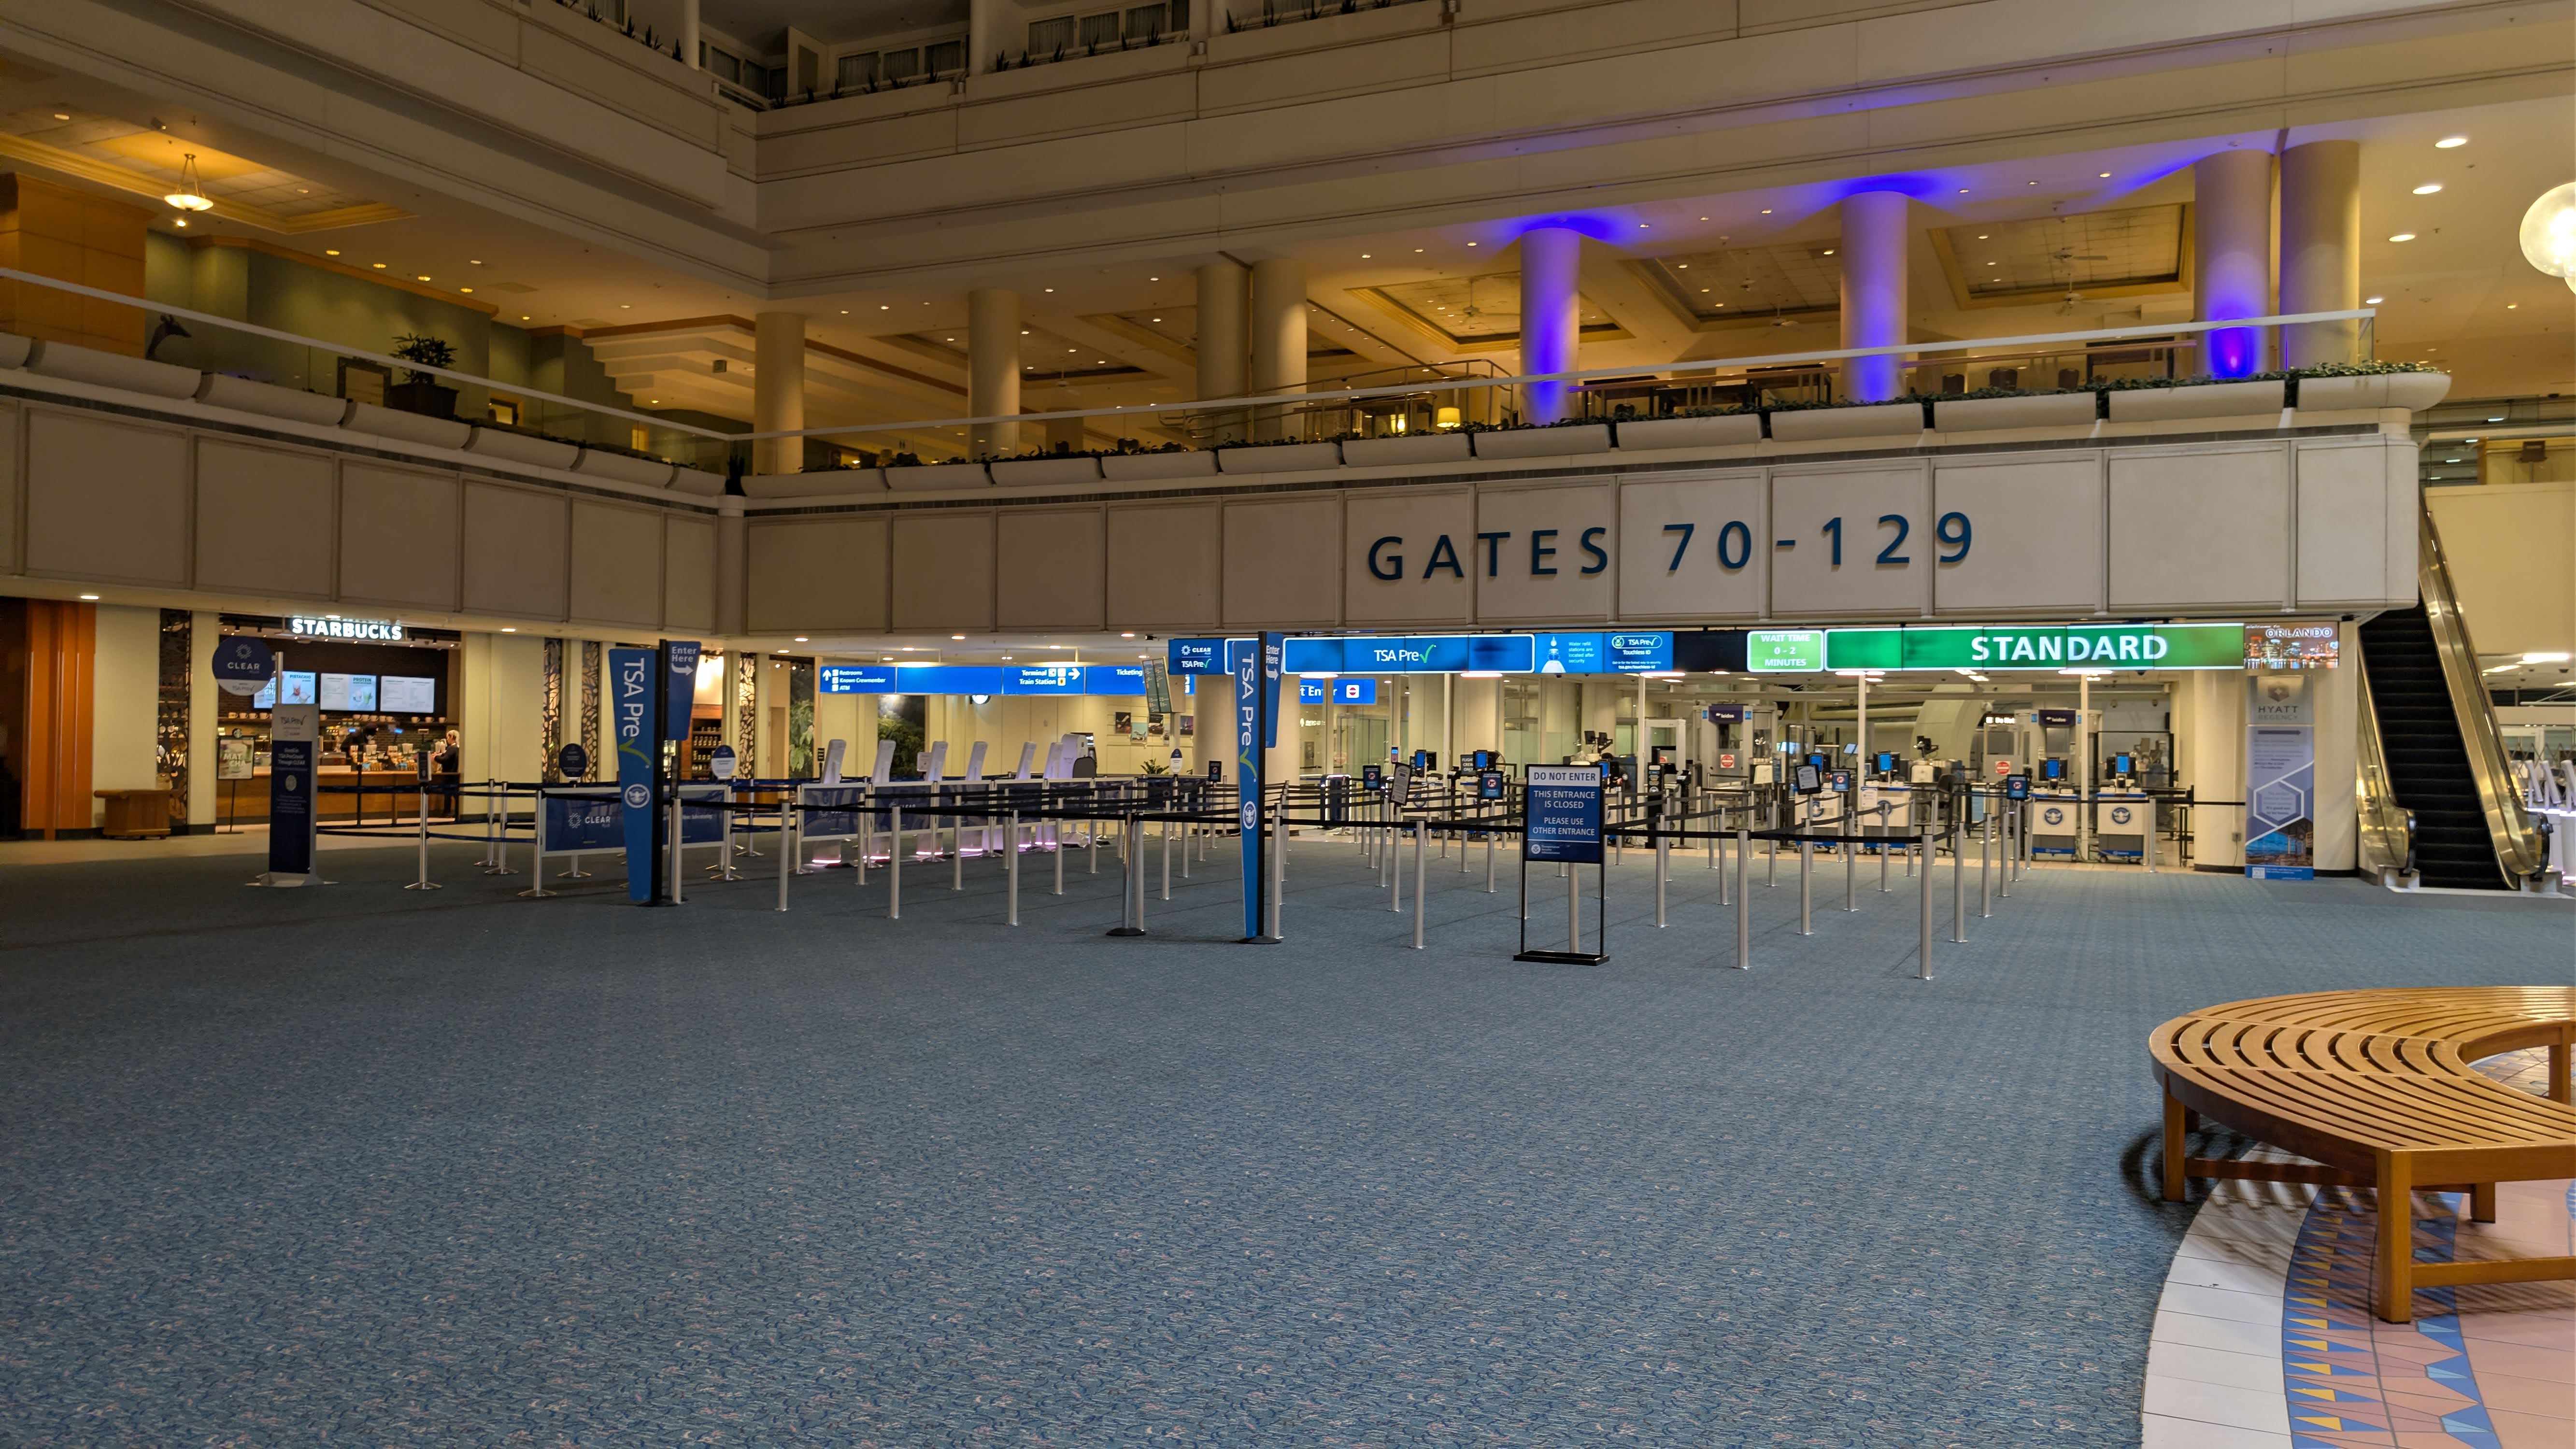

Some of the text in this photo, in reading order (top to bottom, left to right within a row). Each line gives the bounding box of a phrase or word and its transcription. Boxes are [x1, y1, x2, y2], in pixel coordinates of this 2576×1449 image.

[1367, 512, 1973, 581] GATES 70-129
[292, 618, 402, 640] STARBUCKS
[2266, 628, 2333, 638] ORLANDO
[1266, 645, 1280, 655] Enter
[1971, 635, 2167, 661] STANDARD
[1266, 655, 1279, 665] Here
[1374, 650, 1419, 662] TSA Pre
[227, 662, 260, 670] CLEAR
[1309, 686, 1338, 696] Enr
[623, 657, 644, 737] TSA Pre
[1241, 653, 1254, 746] TSA Pre
[1534, 772, 1596, 781] DO NOT ENTER
[1553, 791, 1595, 799] ENTRANCE
[1558, 827, 1595, 836] ENTRANCE
